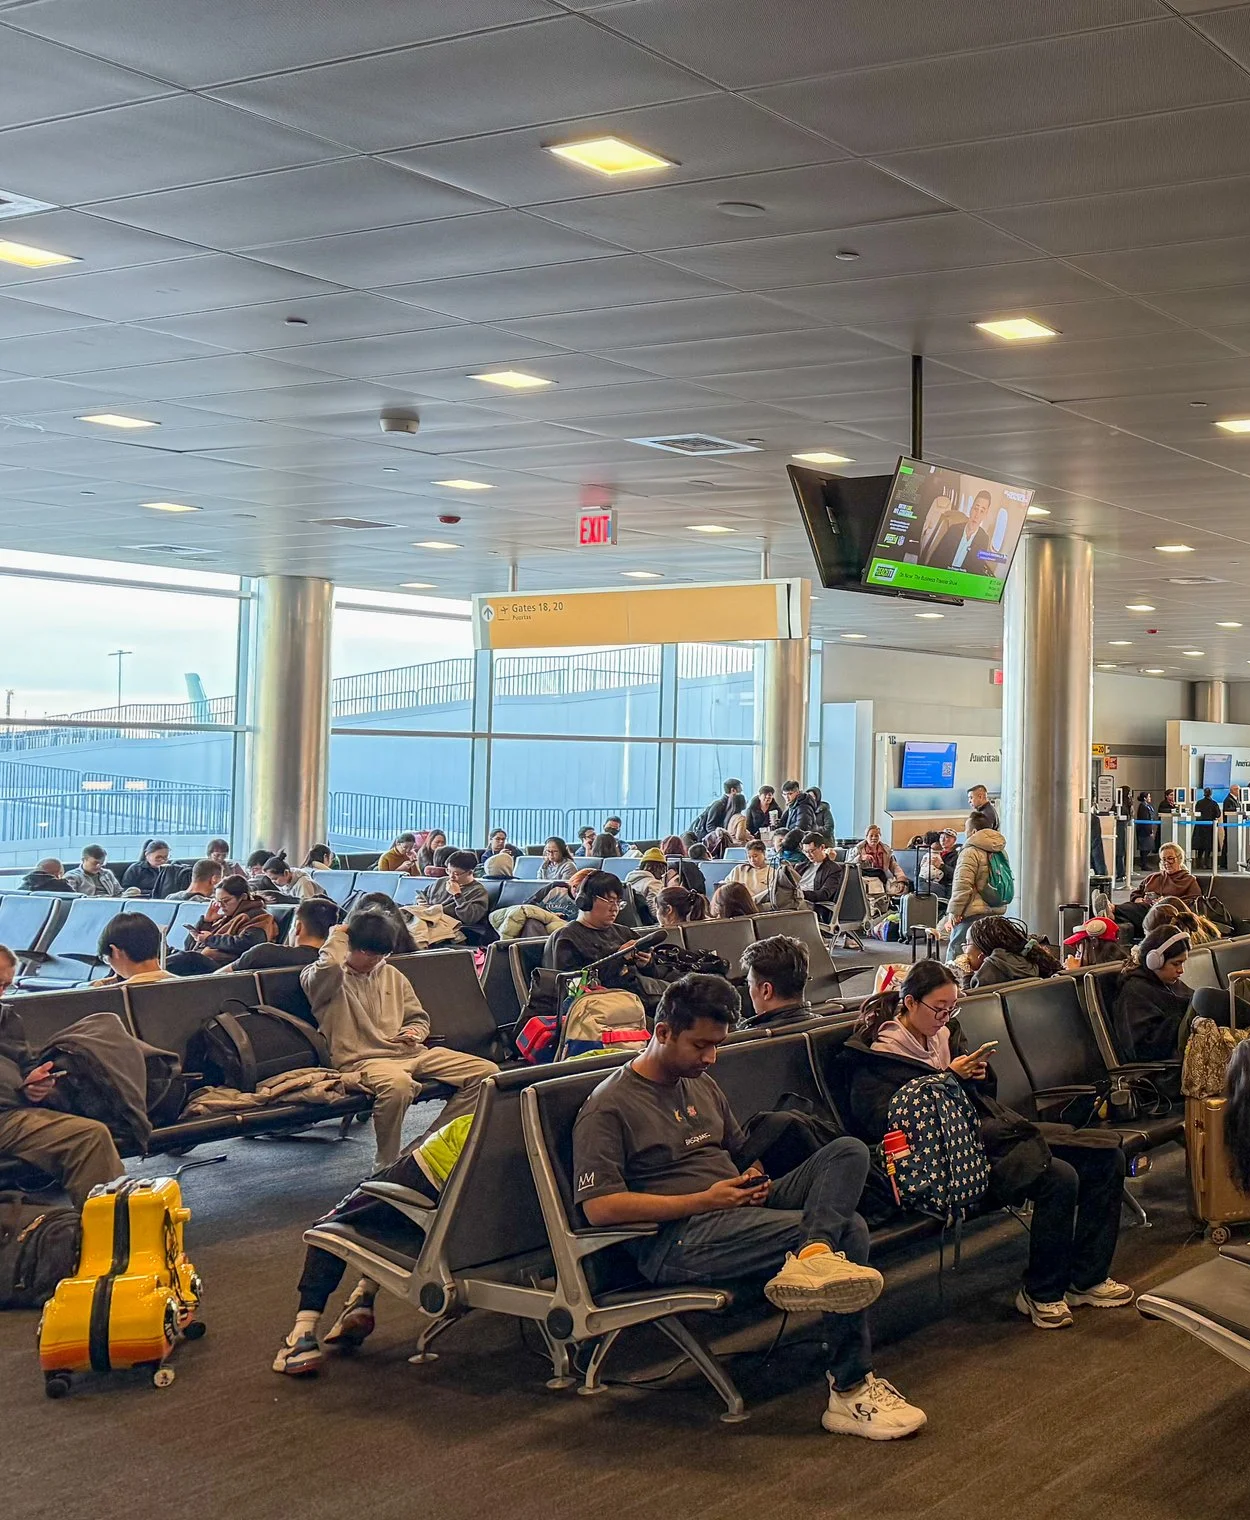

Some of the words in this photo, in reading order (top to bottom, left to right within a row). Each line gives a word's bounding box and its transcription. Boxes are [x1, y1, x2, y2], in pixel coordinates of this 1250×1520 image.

[580, 516, 609, 545] EXIT
[512, 603, 536, 613] Gates
[539, 602, 551, 612] 18,
[553, 601, 564, 611] 20
[969, 752, 1000, 763] American
